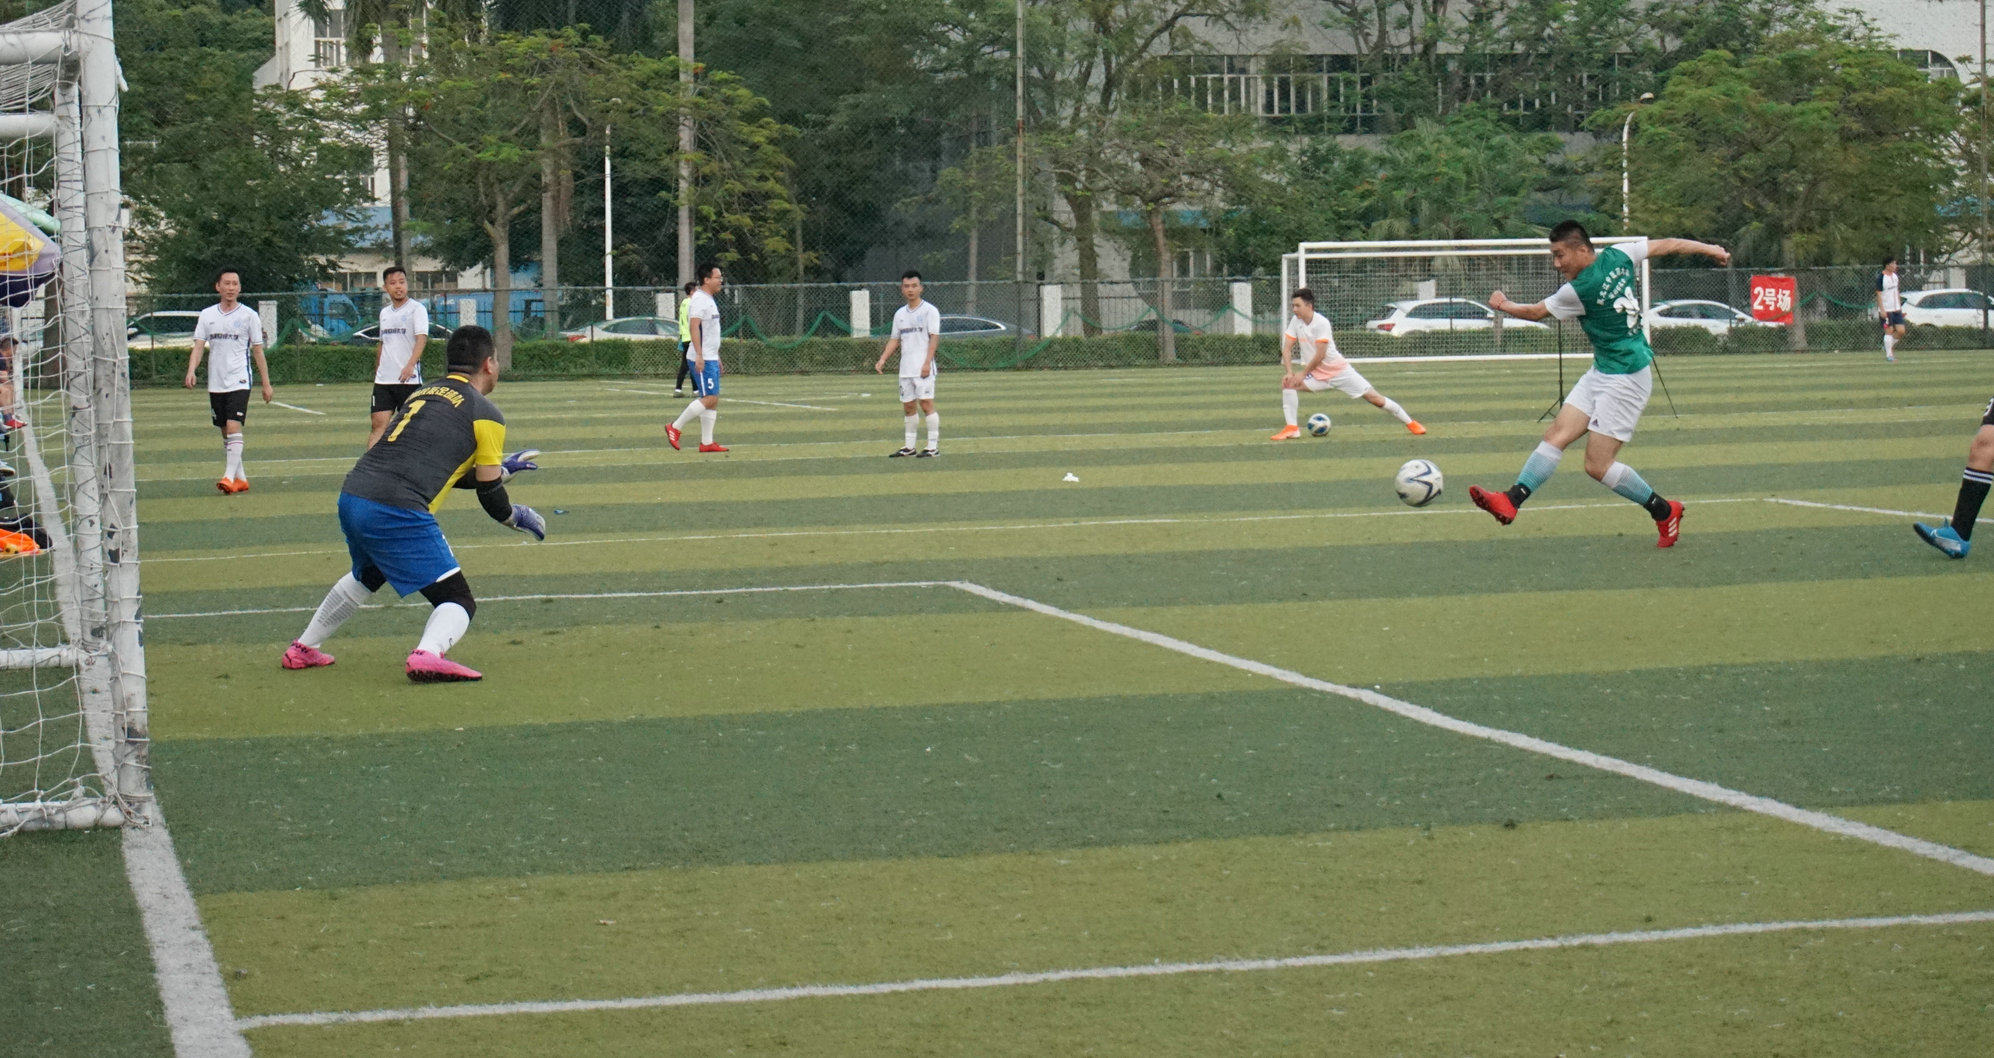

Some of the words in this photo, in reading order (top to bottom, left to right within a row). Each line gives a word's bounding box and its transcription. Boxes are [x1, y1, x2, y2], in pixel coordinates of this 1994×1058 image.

[1753, 286, 1791, 312] 2号场
[707, 378, 714, 390] 5
[387, 399, 426, 442] 1
